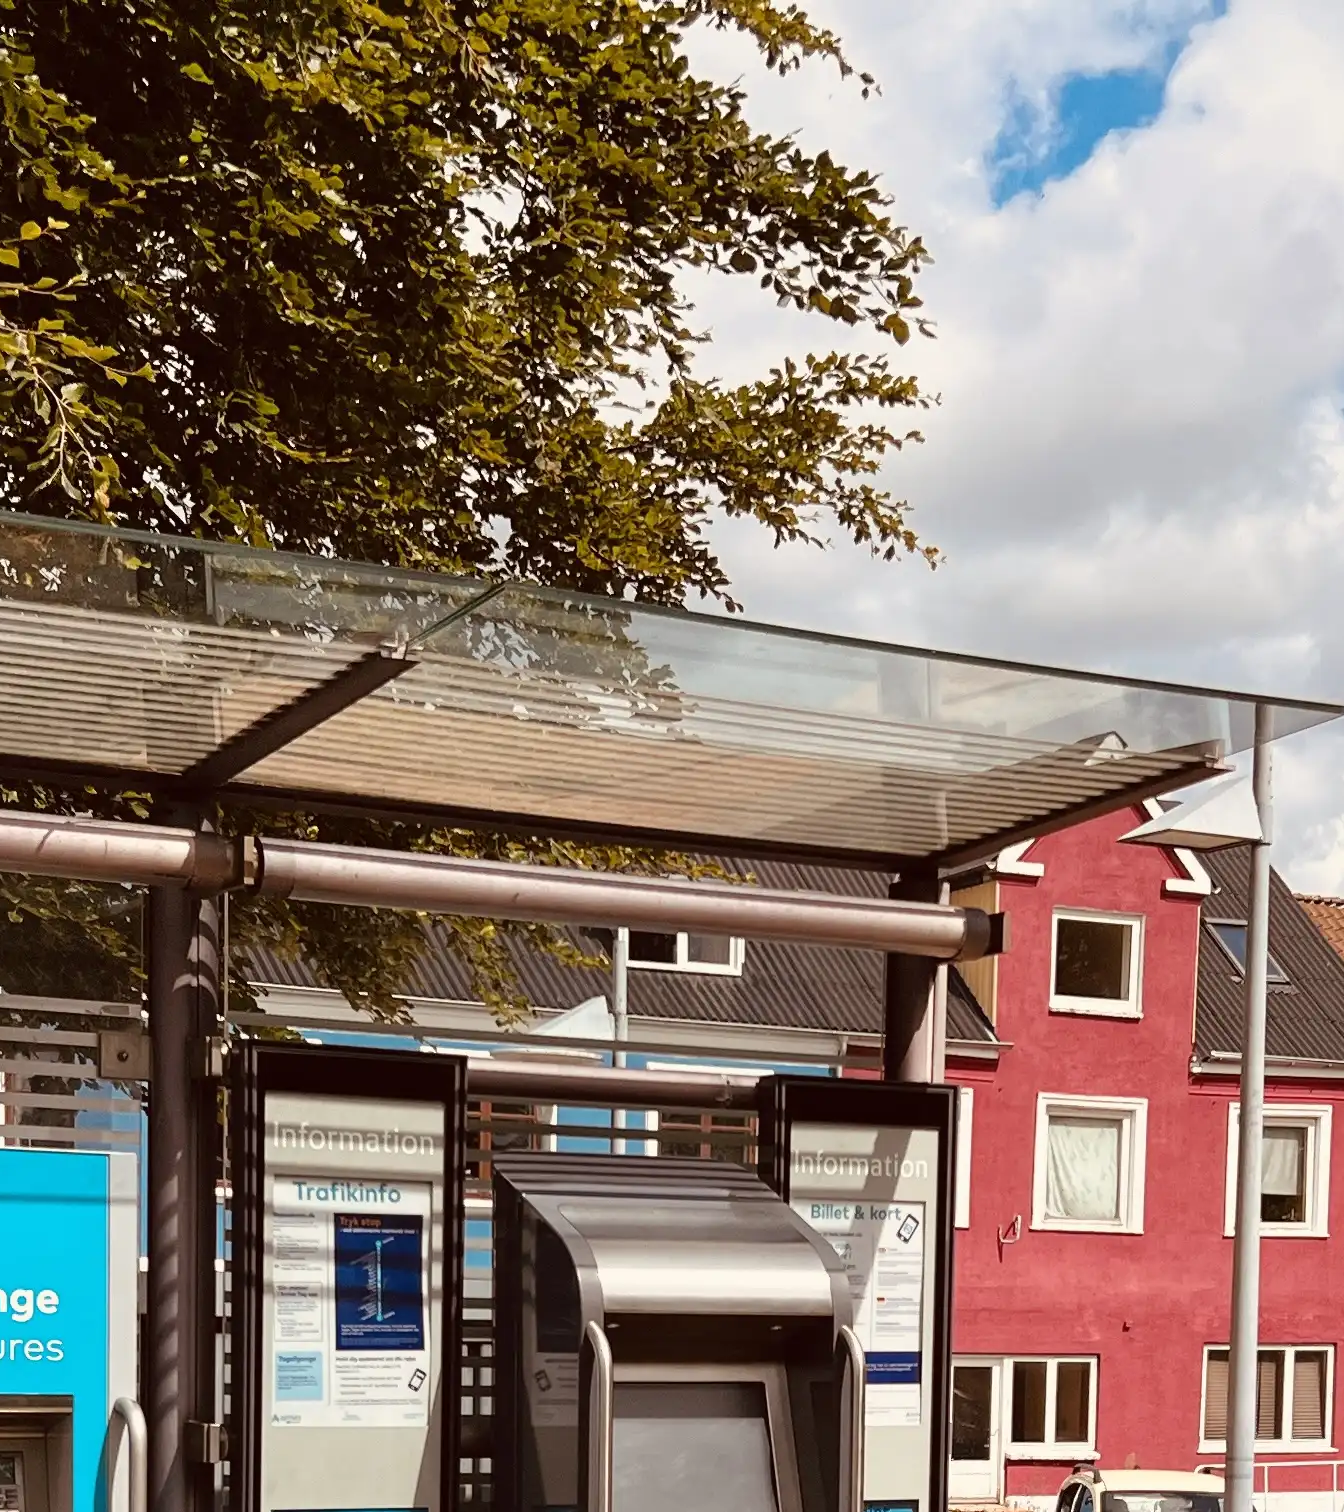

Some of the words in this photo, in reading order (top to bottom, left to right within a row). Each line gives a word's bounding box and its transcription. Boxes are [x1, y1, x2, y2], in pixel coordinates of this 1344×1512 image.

[273, 1121, 434, 1156] Information
[794, 1150, 928, 1179] Information
[292, 1181, 402, 1204] Trafikinfo
[811, 1204, 849, 1220] Billet
[854, 1205, 865, 1221] &
[870, 1205, 901, 1222] kort
